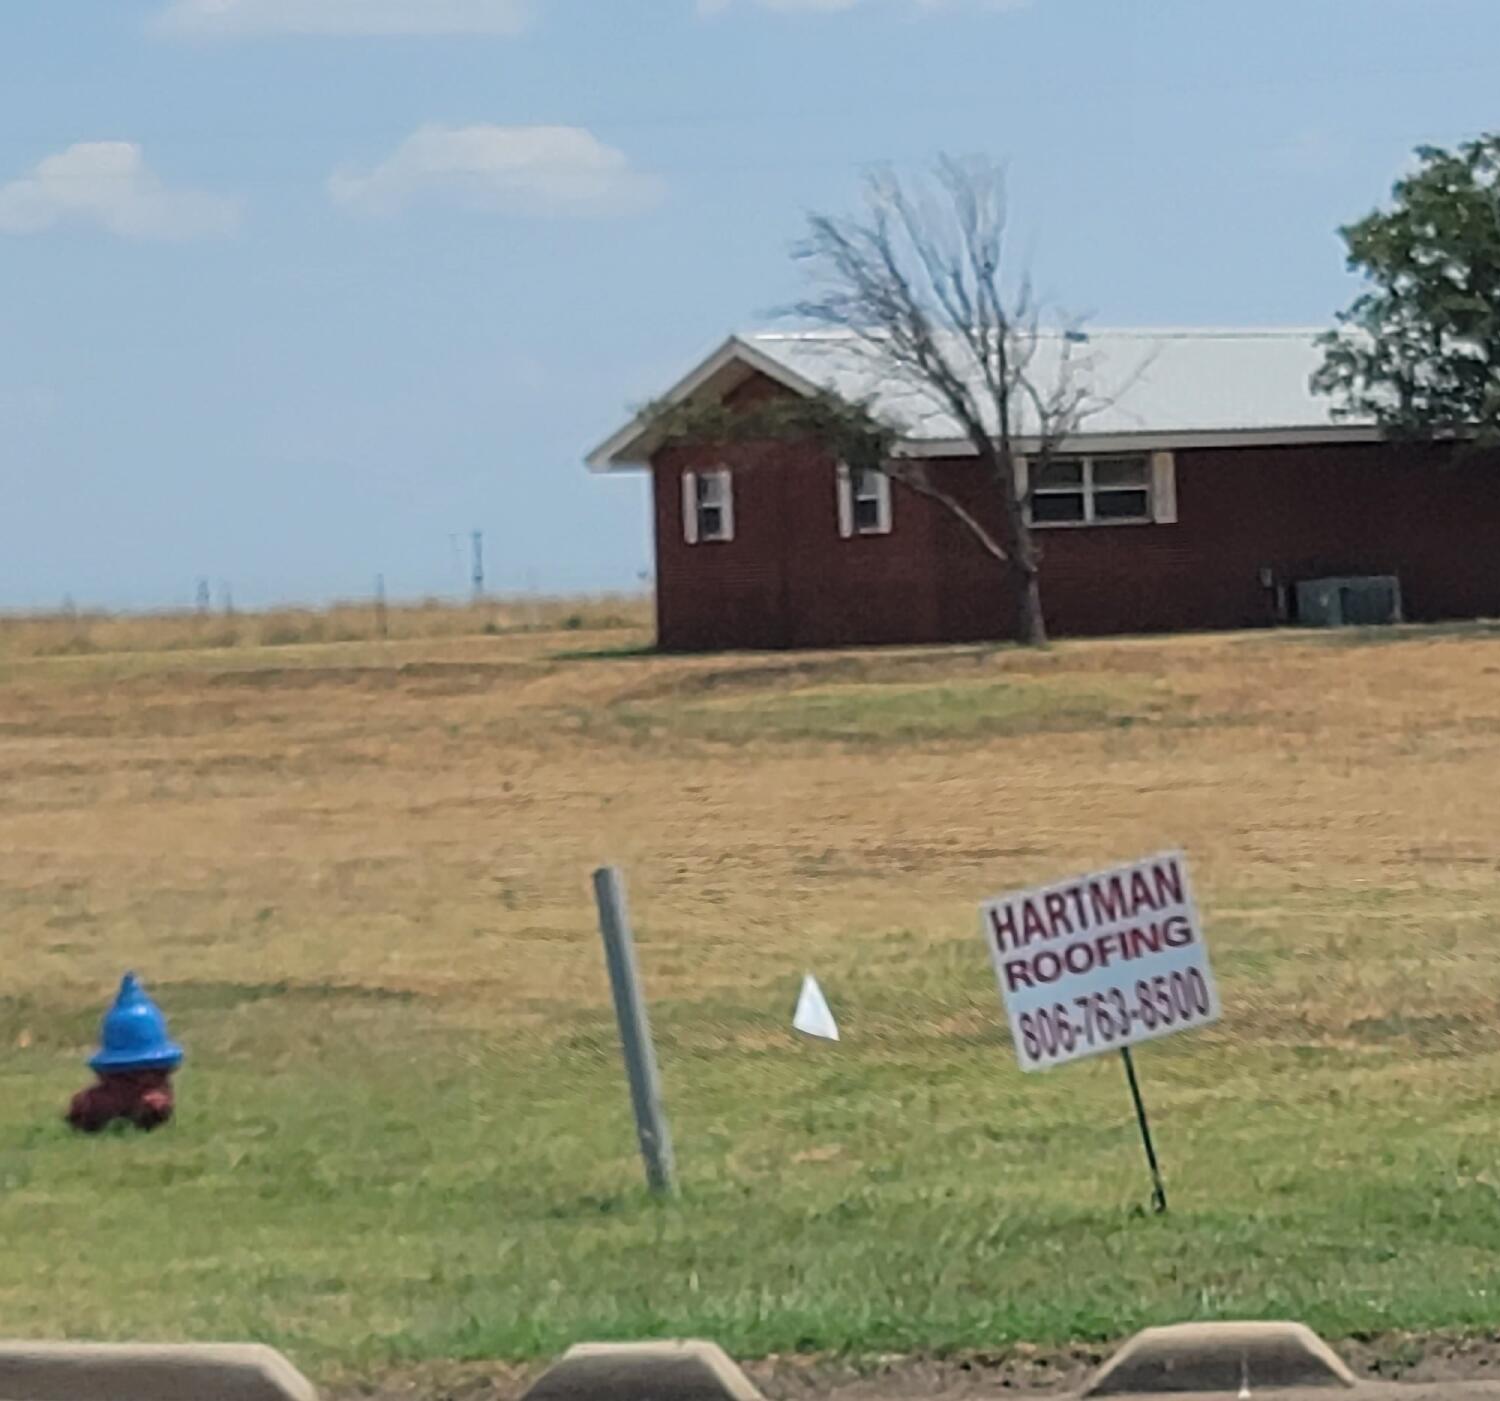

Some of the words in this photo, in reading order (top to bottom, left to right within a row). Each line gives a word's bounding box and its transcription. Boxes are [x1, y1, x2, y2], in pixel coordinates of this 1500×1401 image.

[989, 861, 1184, 951] HARTMAN
[1004, 916, 1193, 993] ROOFING
[1019, 966, 1209, 1061] 806-763-8500
